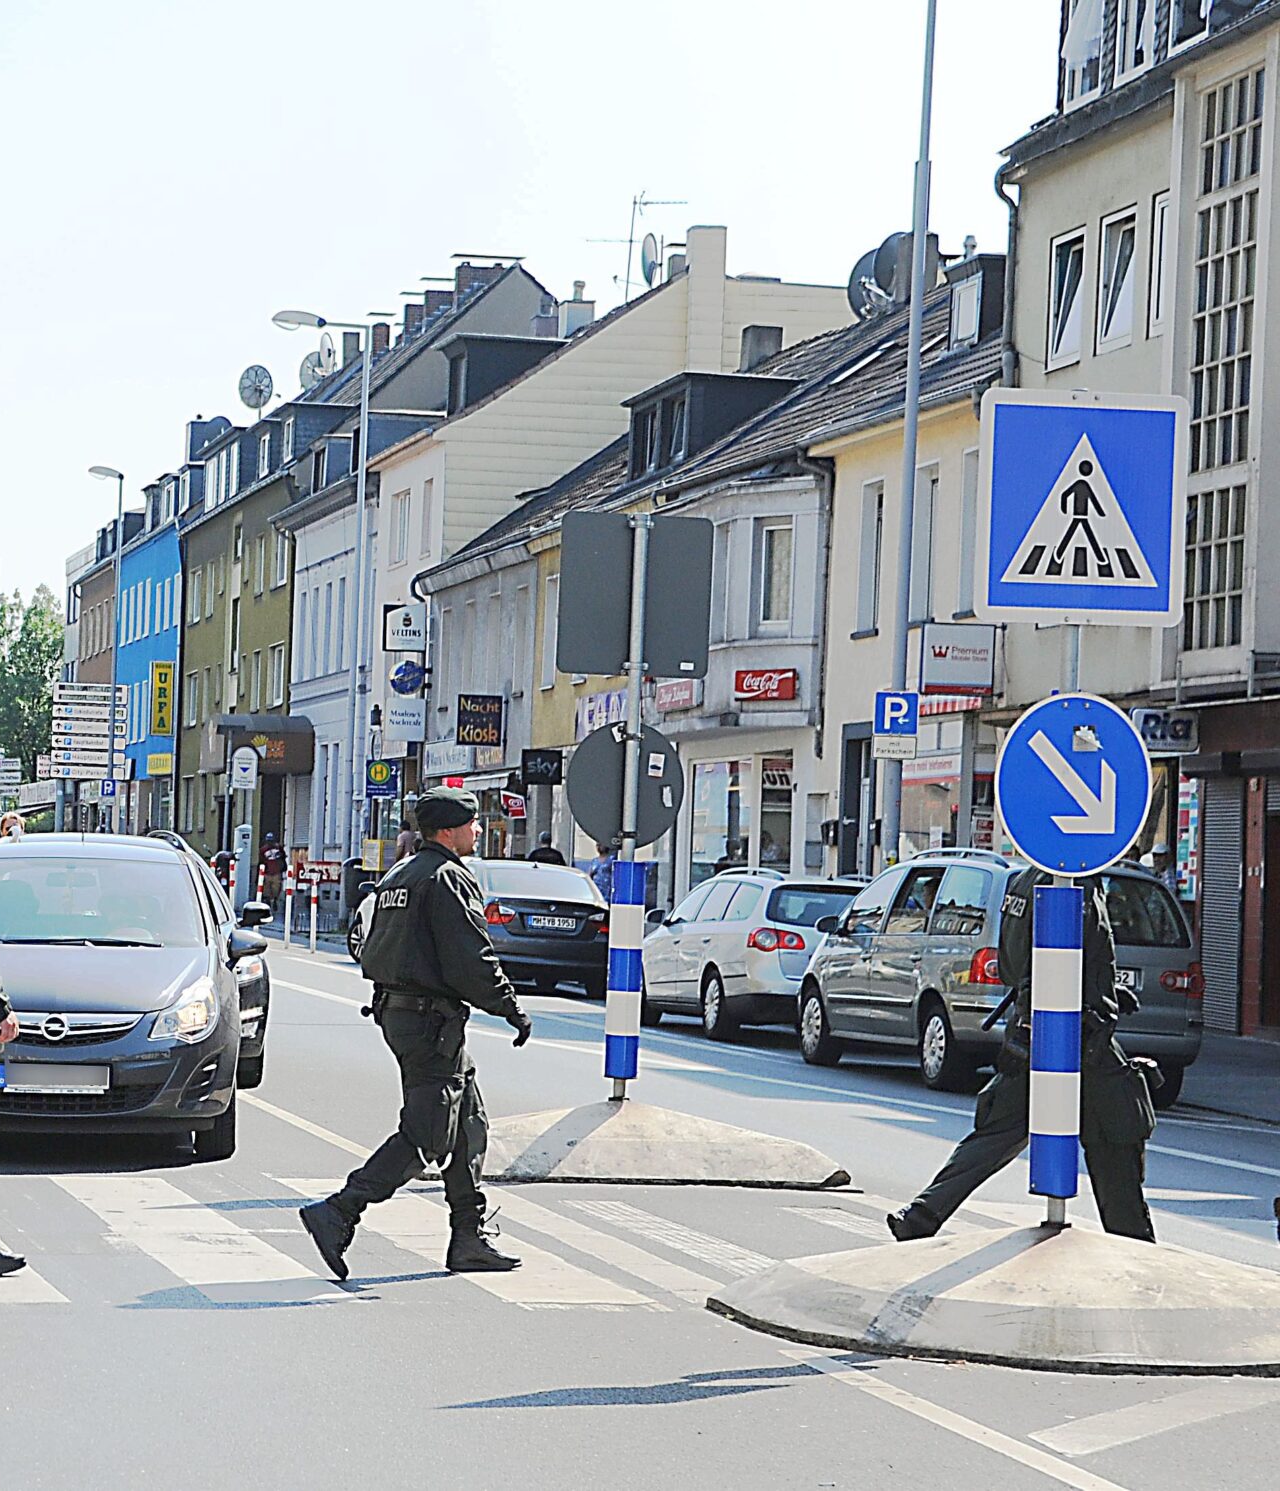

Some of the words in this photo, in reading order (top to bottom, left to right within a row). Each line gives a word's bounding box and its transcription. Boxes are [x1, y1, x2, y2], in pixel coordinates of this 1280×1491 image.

[391, 629, 422, 638] VELTINS
[951, 646, 989, 656] Premium
[157, 672, 169, 729] URFA
[460, 696, 500, 713] Nacht
[883, 696, 909, 730] P
[458, 724, 499, 743] Kiosk
[1140, 713, 1194, 741] Ria
[875, 747, 914, 755] Parkschein
[390, 765, 397, 775] 2
[526, 756, 559, 777] sky
[103, 780, 114, 795] P
[557, 918, 575, 928] 1953
